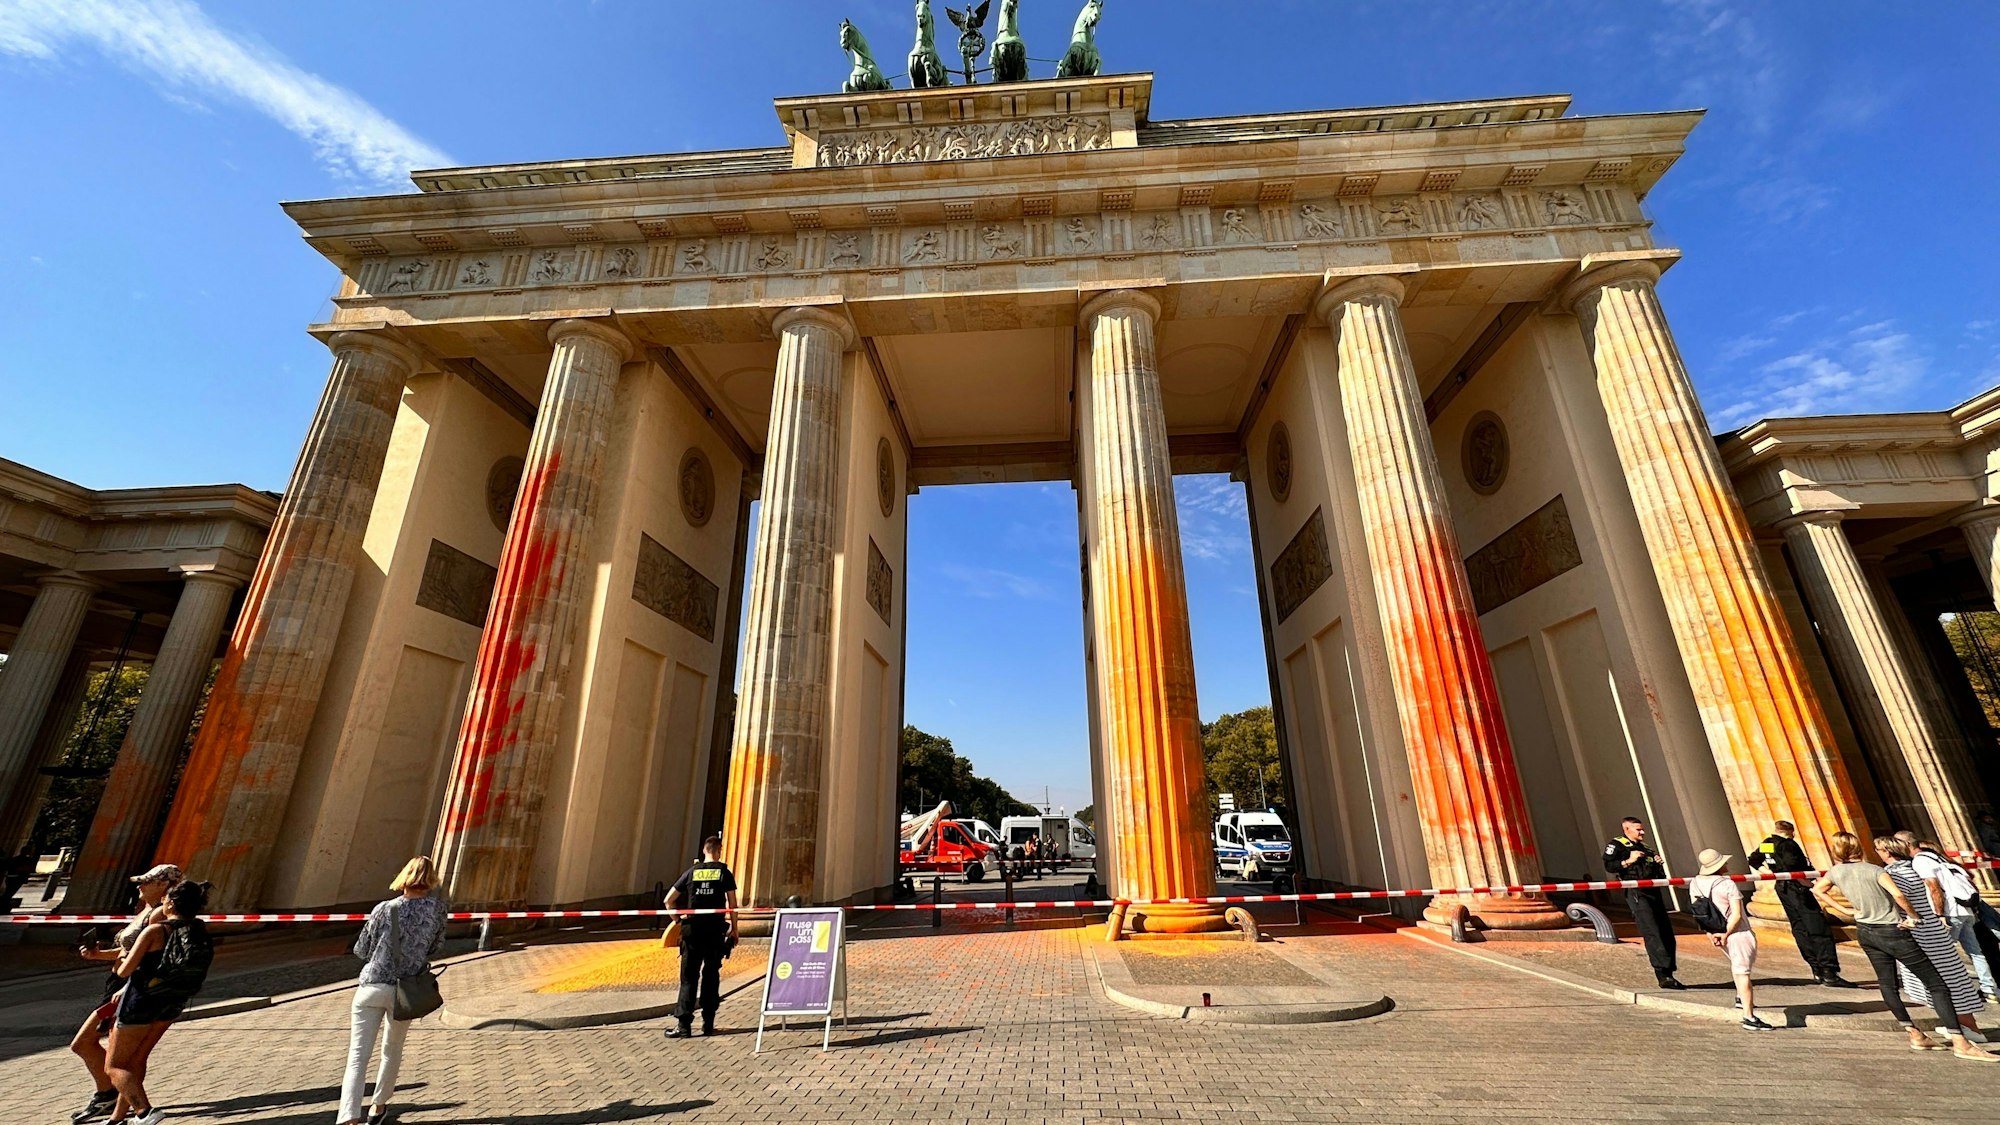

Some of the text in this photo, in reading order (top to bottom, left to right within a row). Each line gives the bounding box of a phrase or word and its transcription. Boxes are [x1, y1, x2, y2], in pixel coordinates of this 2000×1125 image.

[785, 921, 812, 929] muse
[798, 928, 813, 936] um
[788, 936, 812, 946] pass
